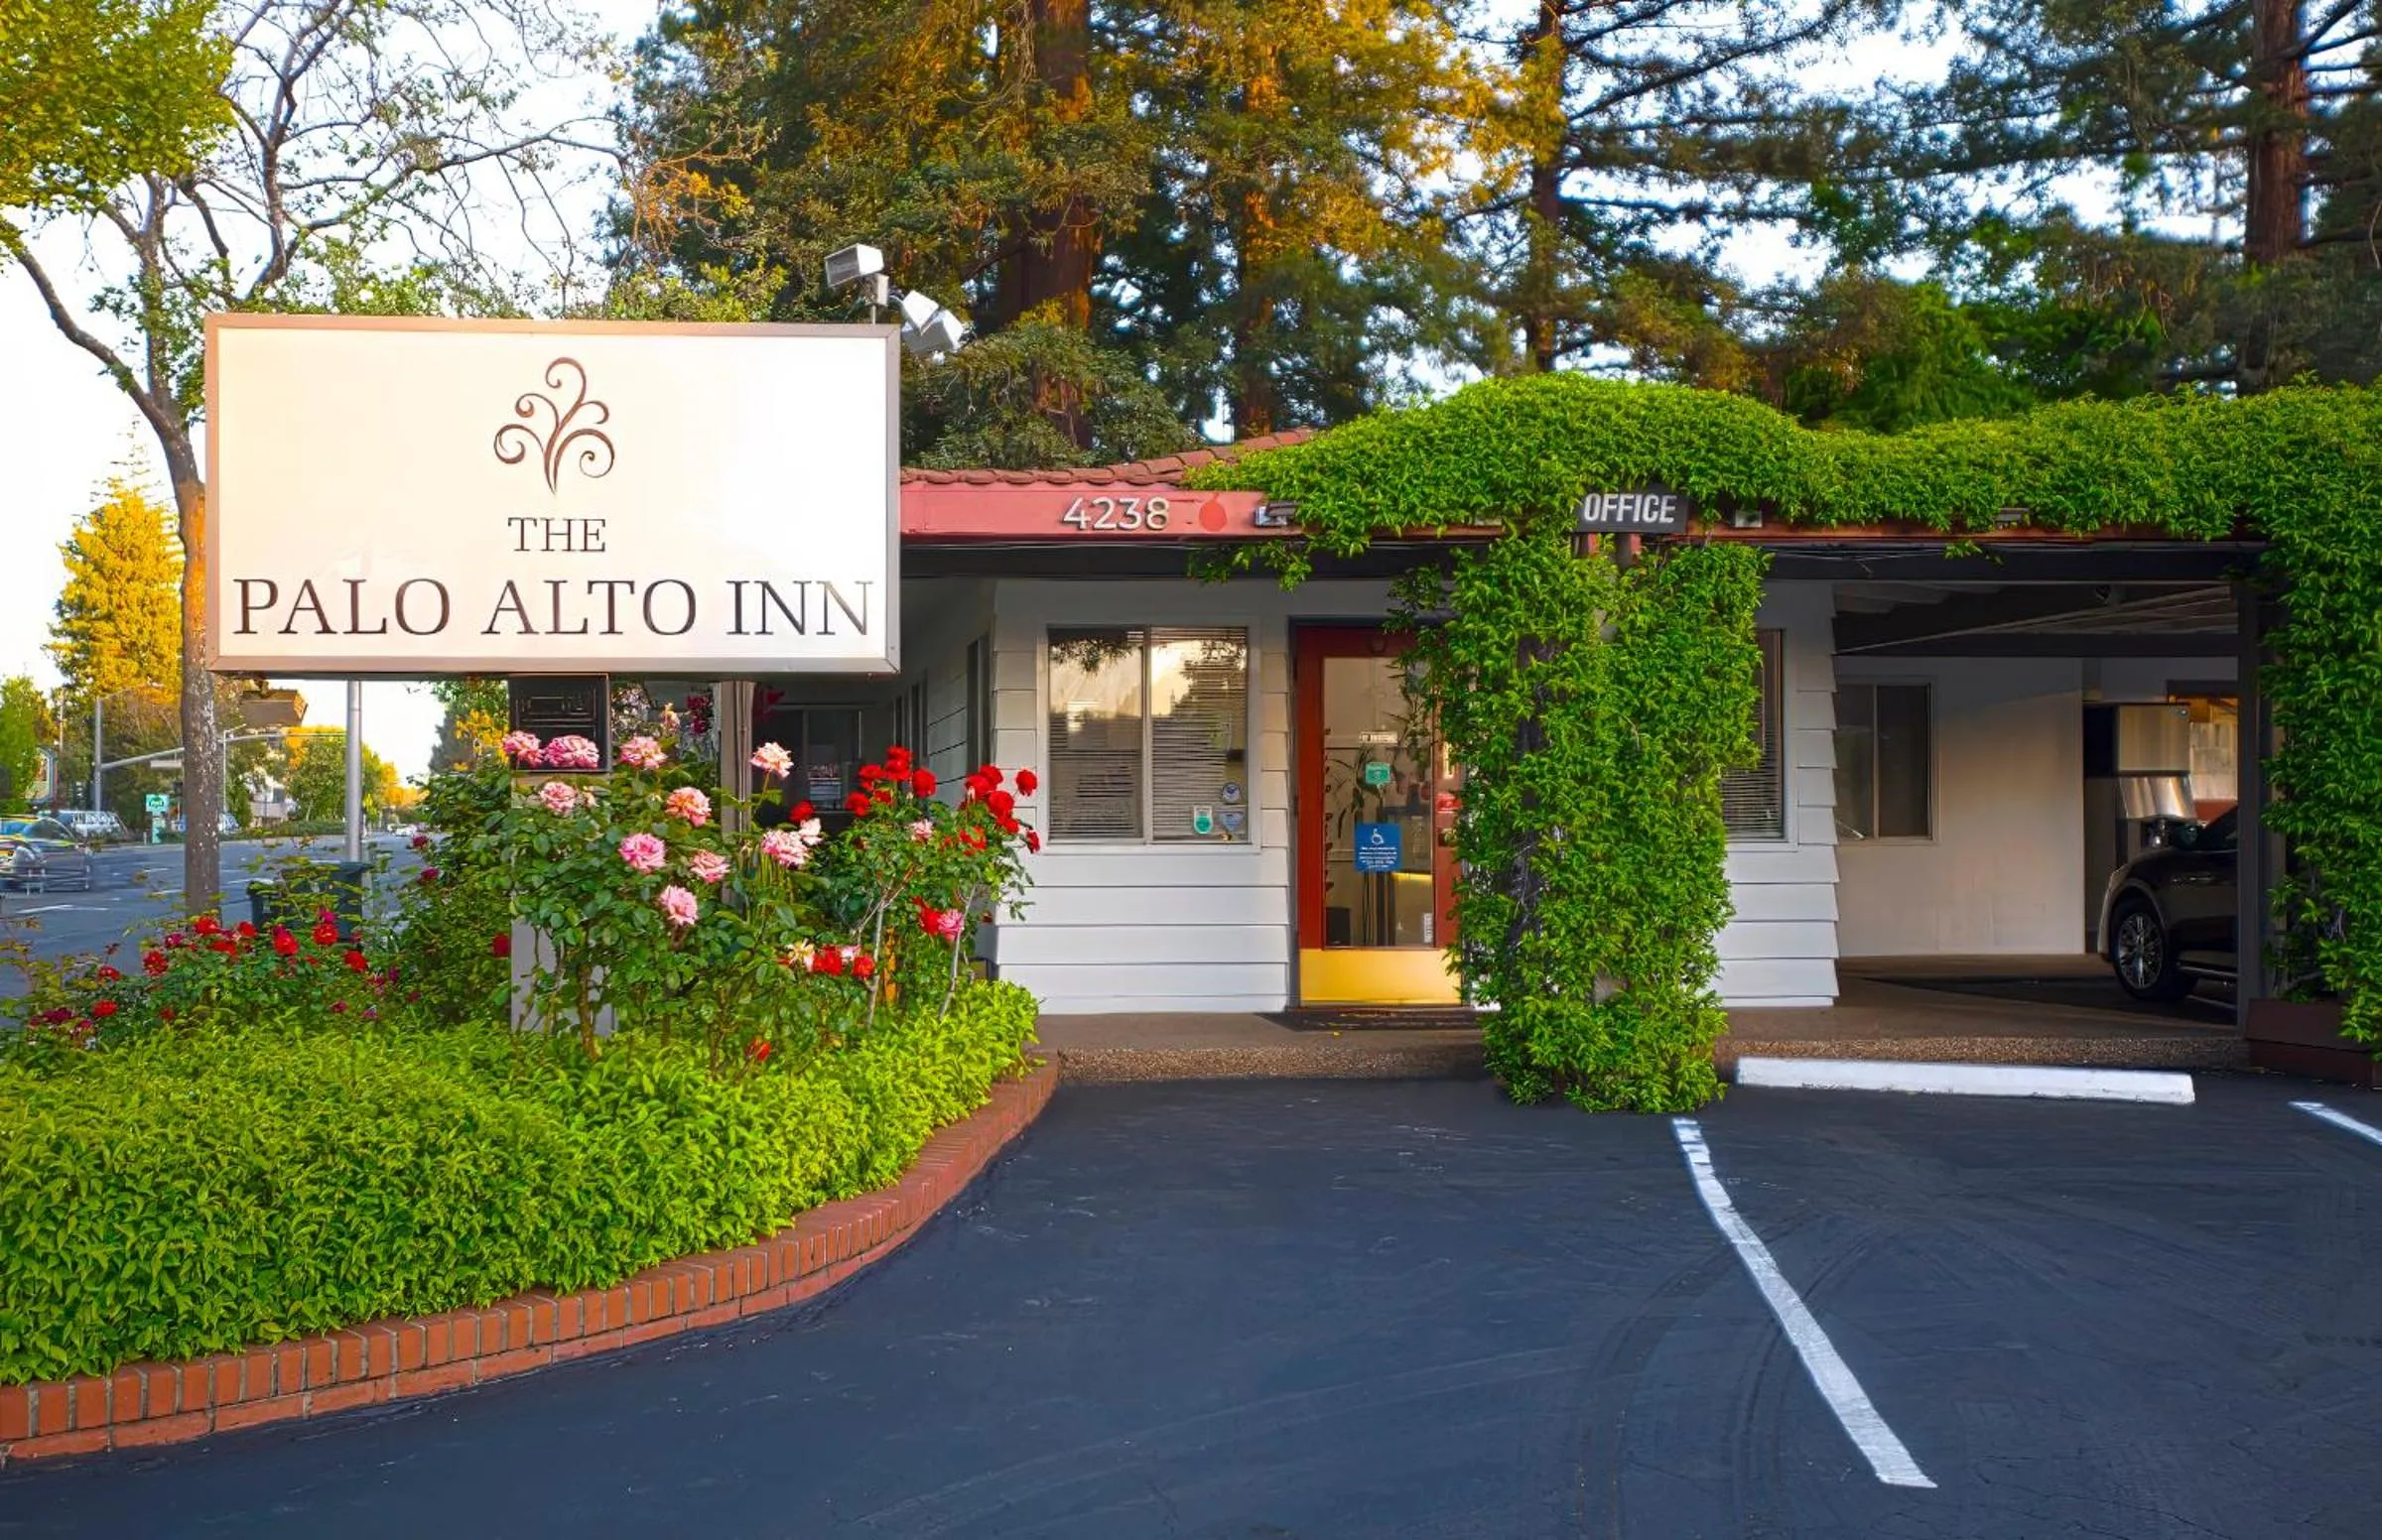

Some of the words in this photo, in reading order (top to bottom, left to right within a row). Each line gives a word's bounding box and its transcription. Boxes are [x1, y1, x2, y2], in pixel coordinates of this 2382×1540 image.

[1062, 496, 1170, 530] 4238
[1583, 493, 1677, 524] OFFICE
[507, 517, 606, 553] THE
[232, 578, 451, 636] PALO
[480, 578, 697, 636] ALTO
[726, 578, 873, 636] INN
